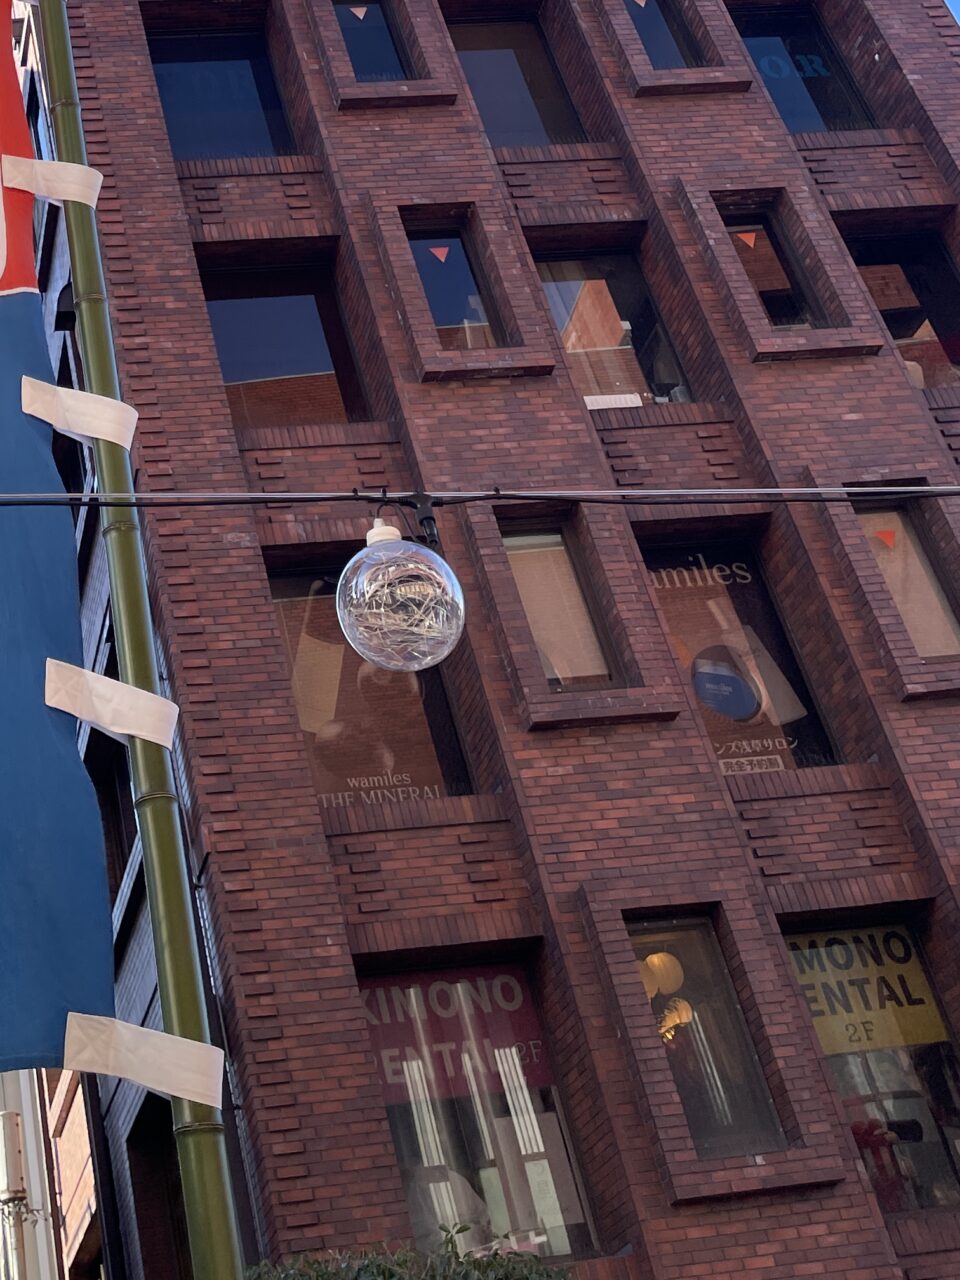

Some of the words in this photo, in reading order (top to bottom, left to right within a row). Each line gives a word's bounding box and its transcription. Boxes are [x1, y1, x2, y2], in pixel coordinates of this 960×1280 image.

[346, 770, 412, 788] wamiles
[844, 1021, 875, 1043] 2F
[372, 1038, 502, 1085] ENTAL
